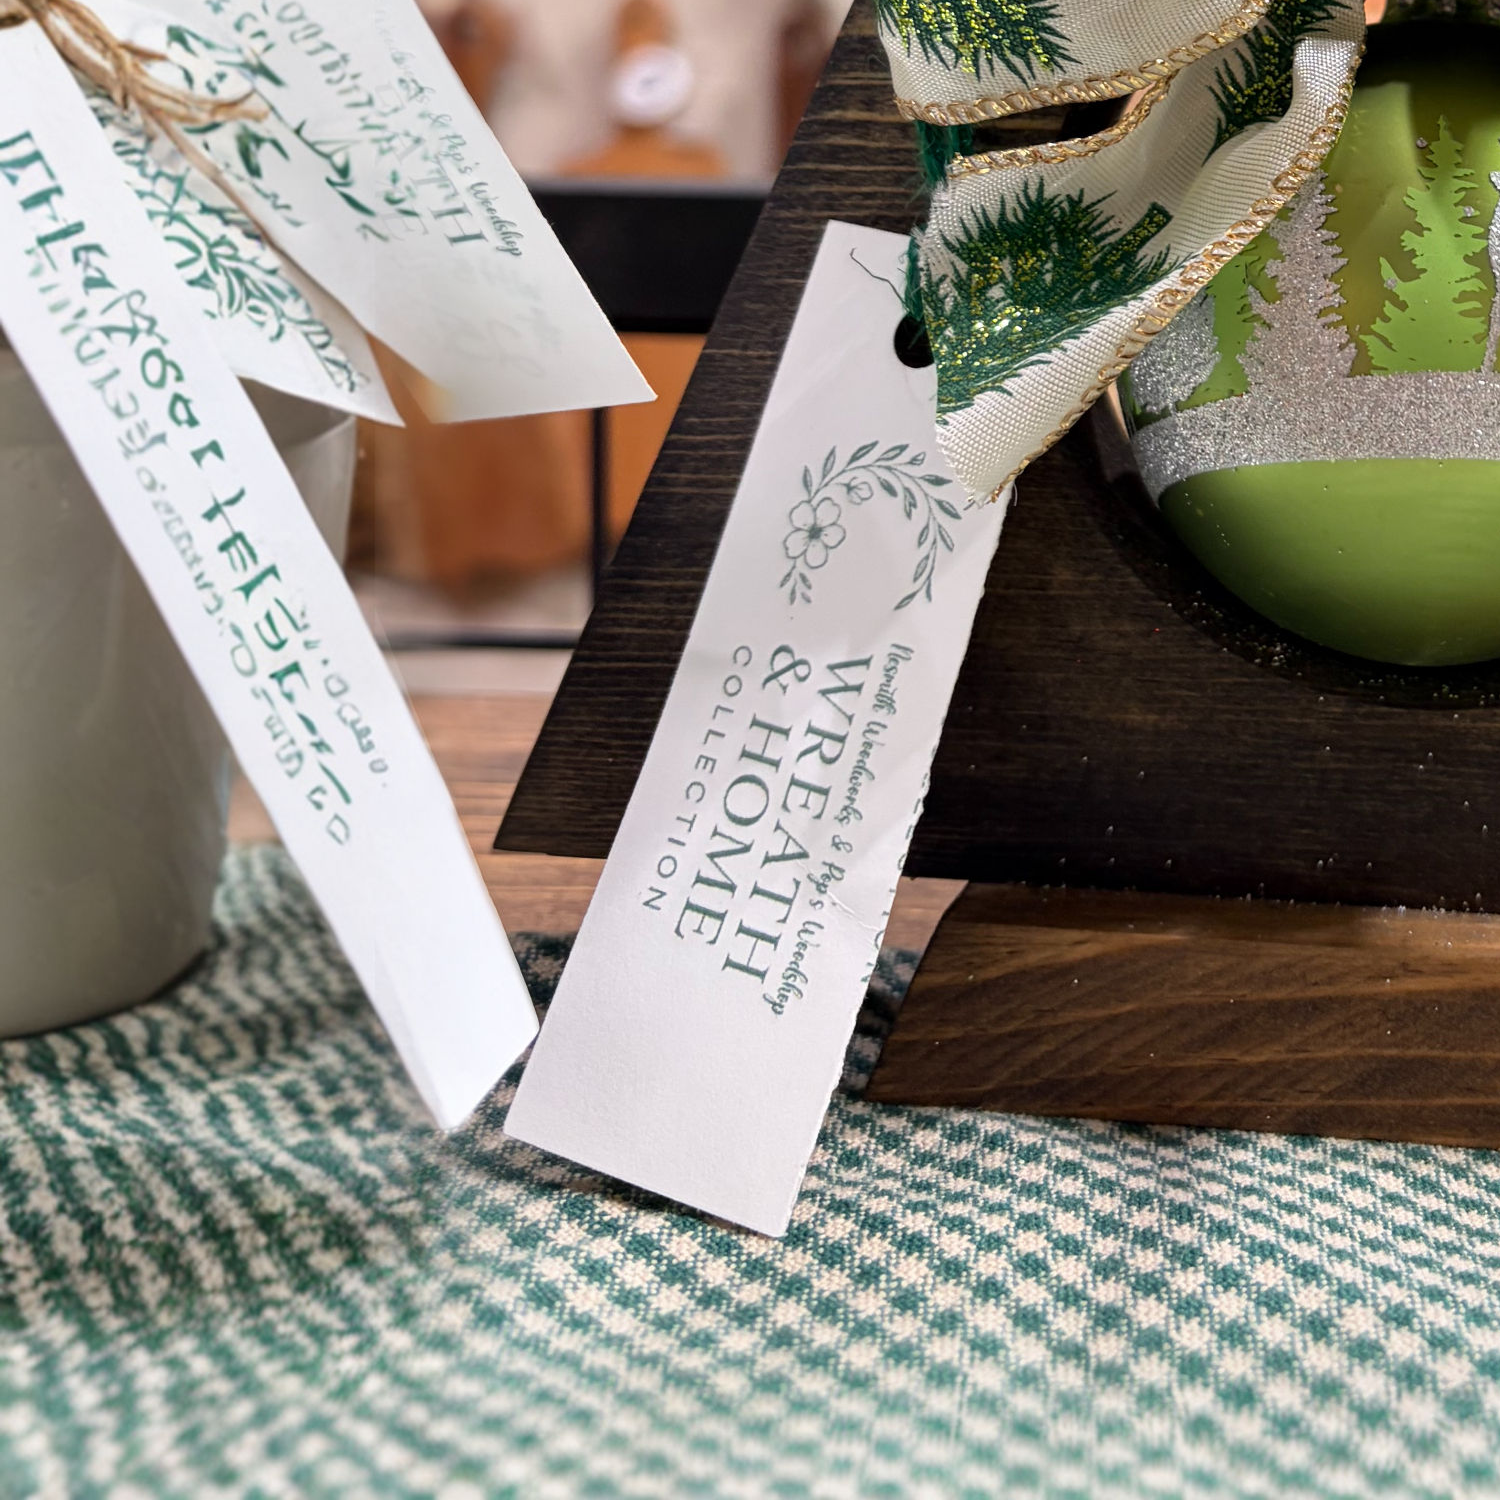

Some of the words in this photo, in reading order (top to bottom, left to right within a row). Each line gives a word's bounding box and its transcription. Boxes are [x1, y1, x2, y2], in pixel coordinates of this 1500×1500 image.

[468, 181, 524, 258] Woodshop
[762, 643, 812, 697] &
[872, 642, 915, 716] Nesmith
[642, 644, 753, 911] COLLECTION
[833, 720, 888, 826] Woodworks
[674, 712, 793, 946] HOME
[721, 653, 875, 985] WREATH
[831, 834, 854, 854] &
[806, 860, 846, 910] Pop's
[762, 919, 825, 1016] Woodshop
